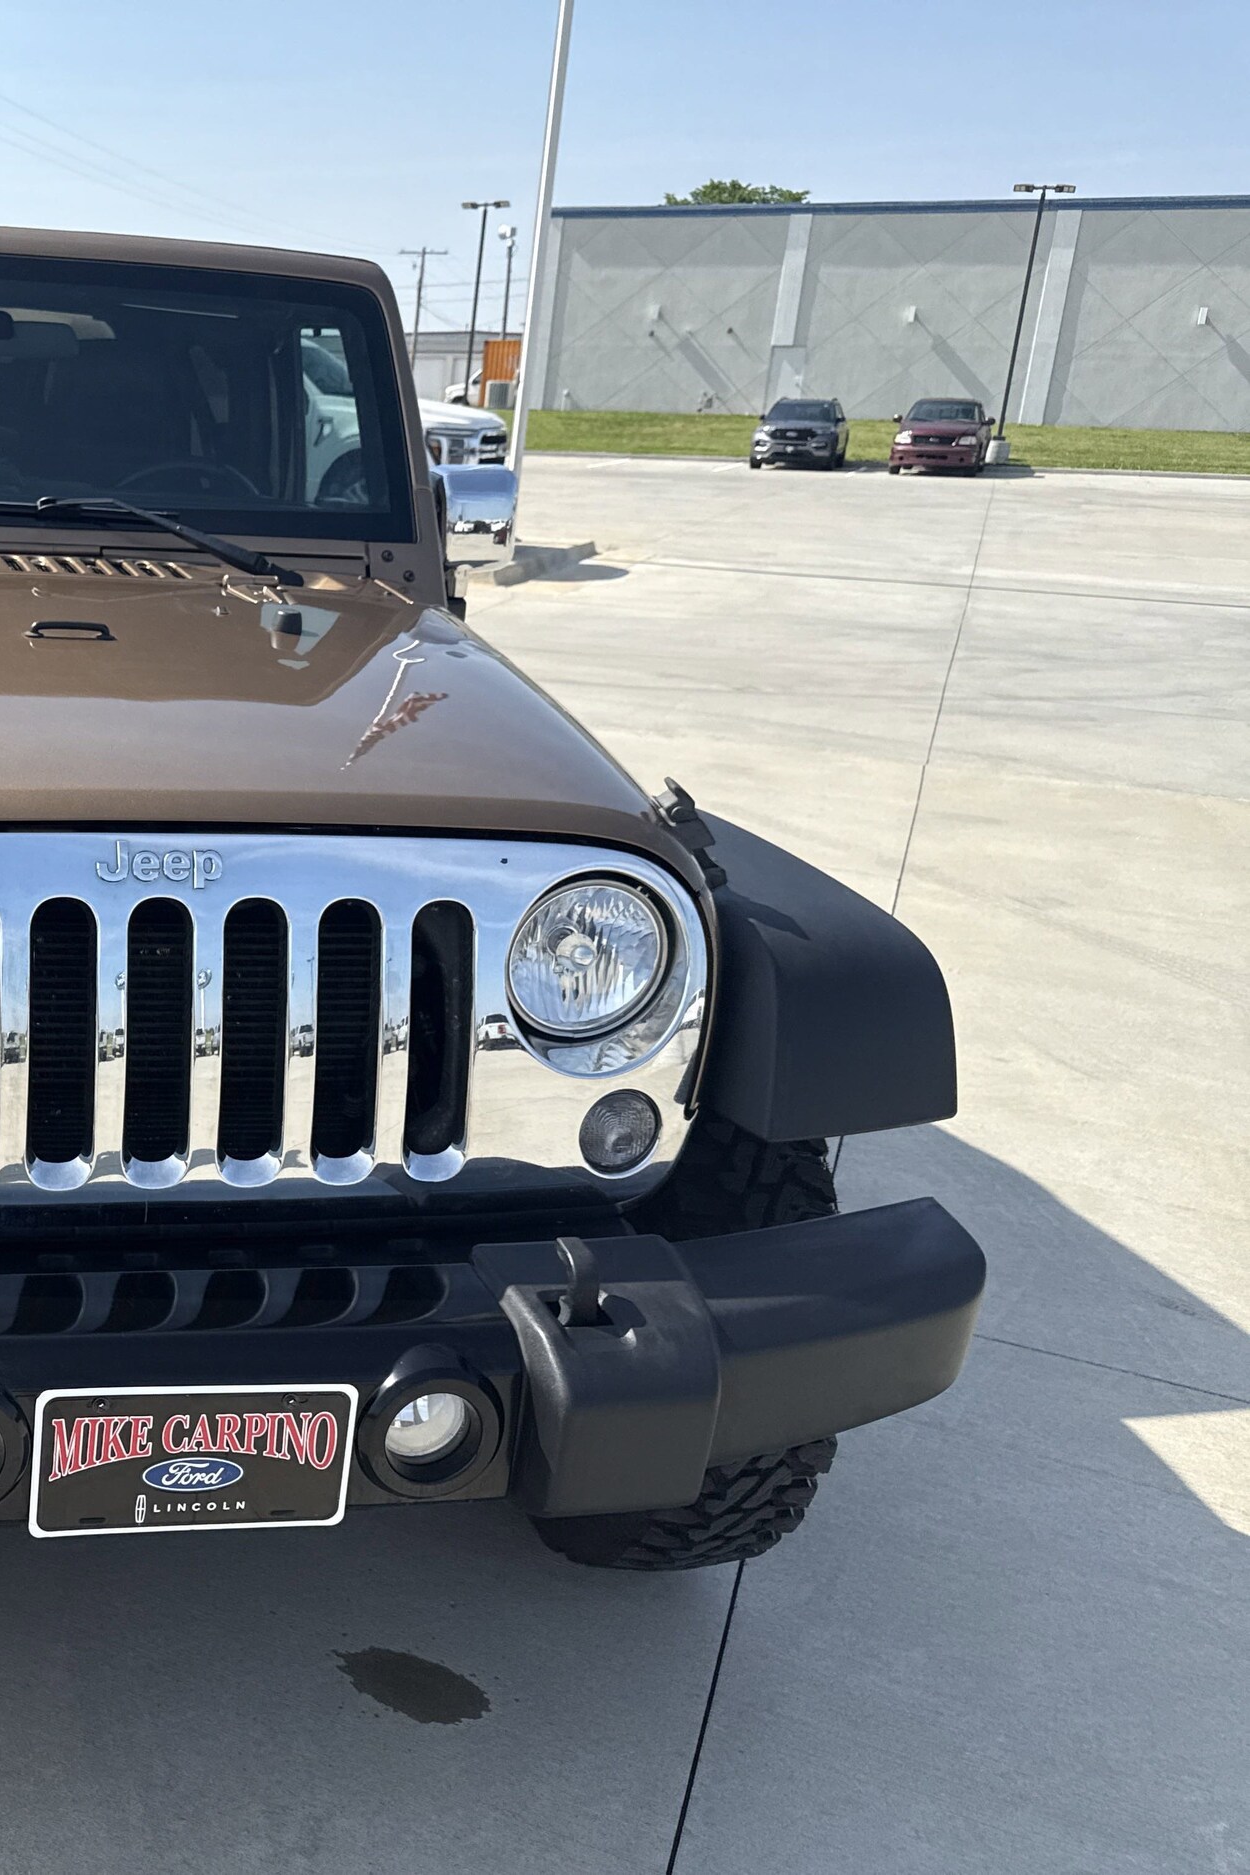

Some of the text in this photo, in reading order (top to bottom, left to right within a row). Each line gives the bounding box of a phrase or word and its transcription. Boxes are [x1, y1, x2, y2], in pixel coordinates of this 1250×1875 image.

[95, 839, 223, 889] Jeep
[49, 1411, 338, 1481] MIKE CARPINO
[161, 1462, 224, 1486] Ford
[153, 1501, 246, 1513] LINCOLN
